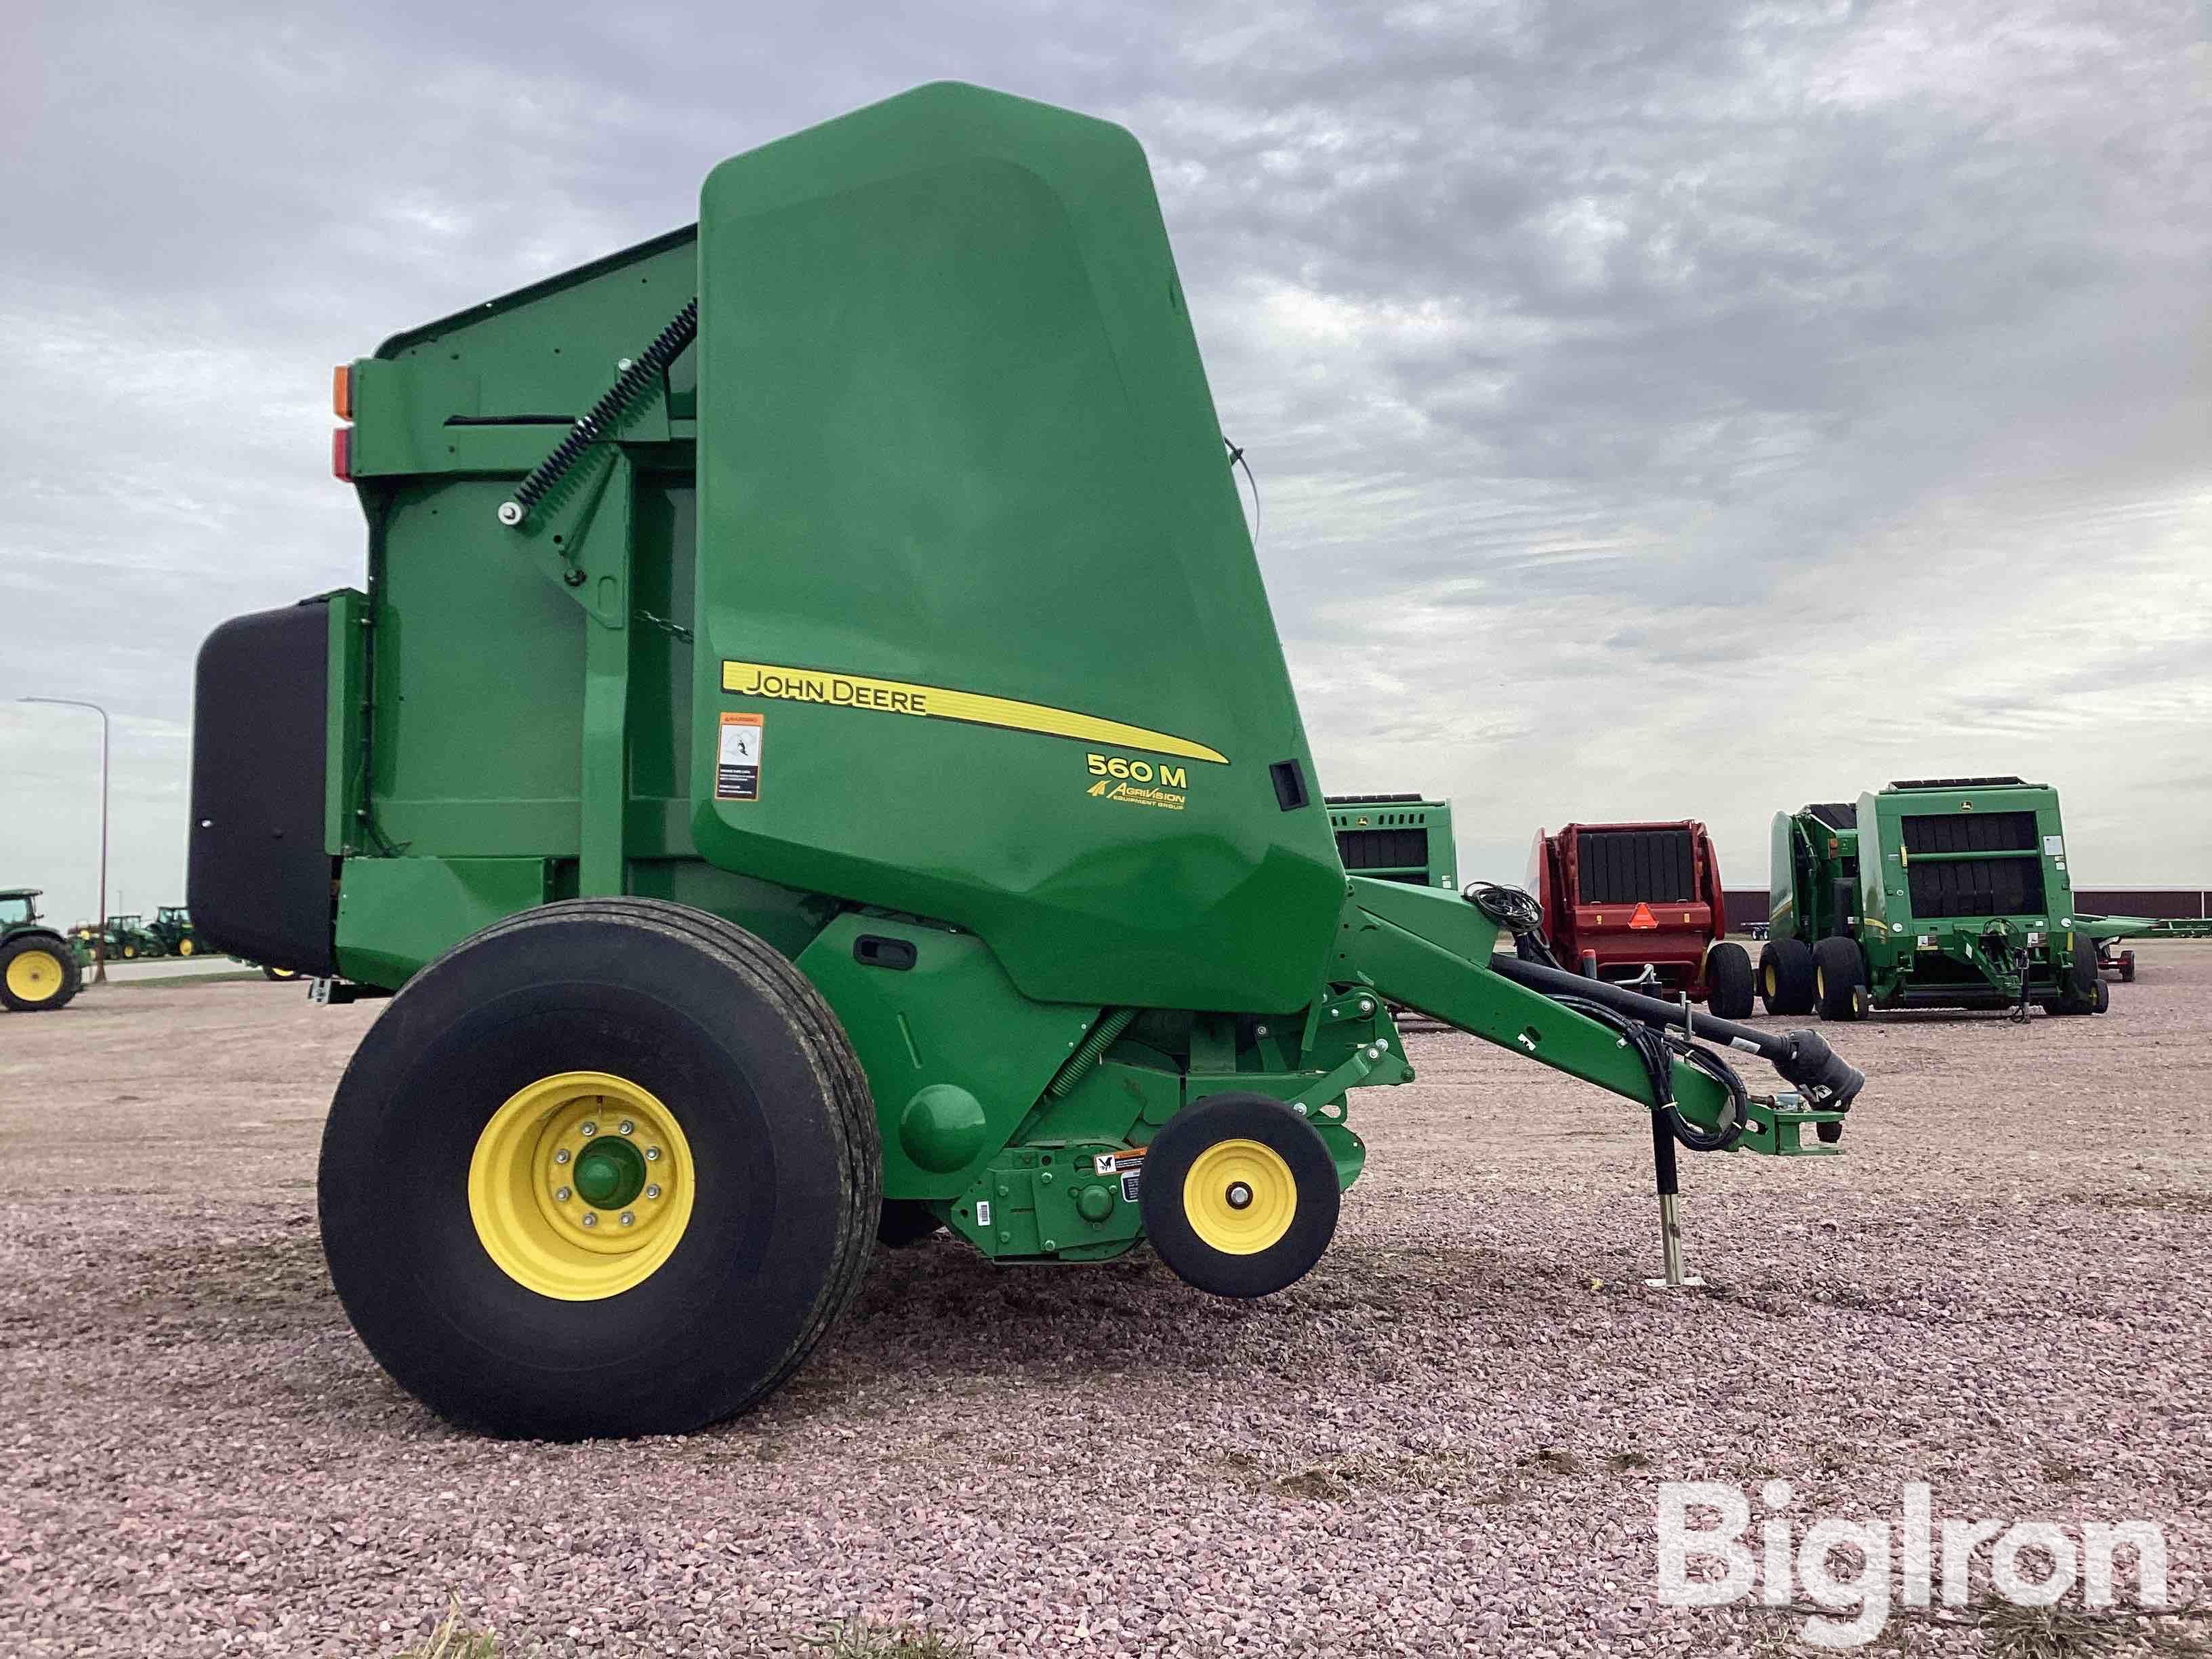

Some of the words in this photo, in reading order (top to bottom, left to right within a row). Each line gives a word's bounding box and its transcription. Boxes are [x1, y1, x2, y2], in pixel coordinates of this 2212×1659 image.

[747, 670, 823, 699] JOHN
[833, 680, 927, 713] DEERE
[1086, 753, 1153, 783] 560
[1159, 764, 1187, 789] M
